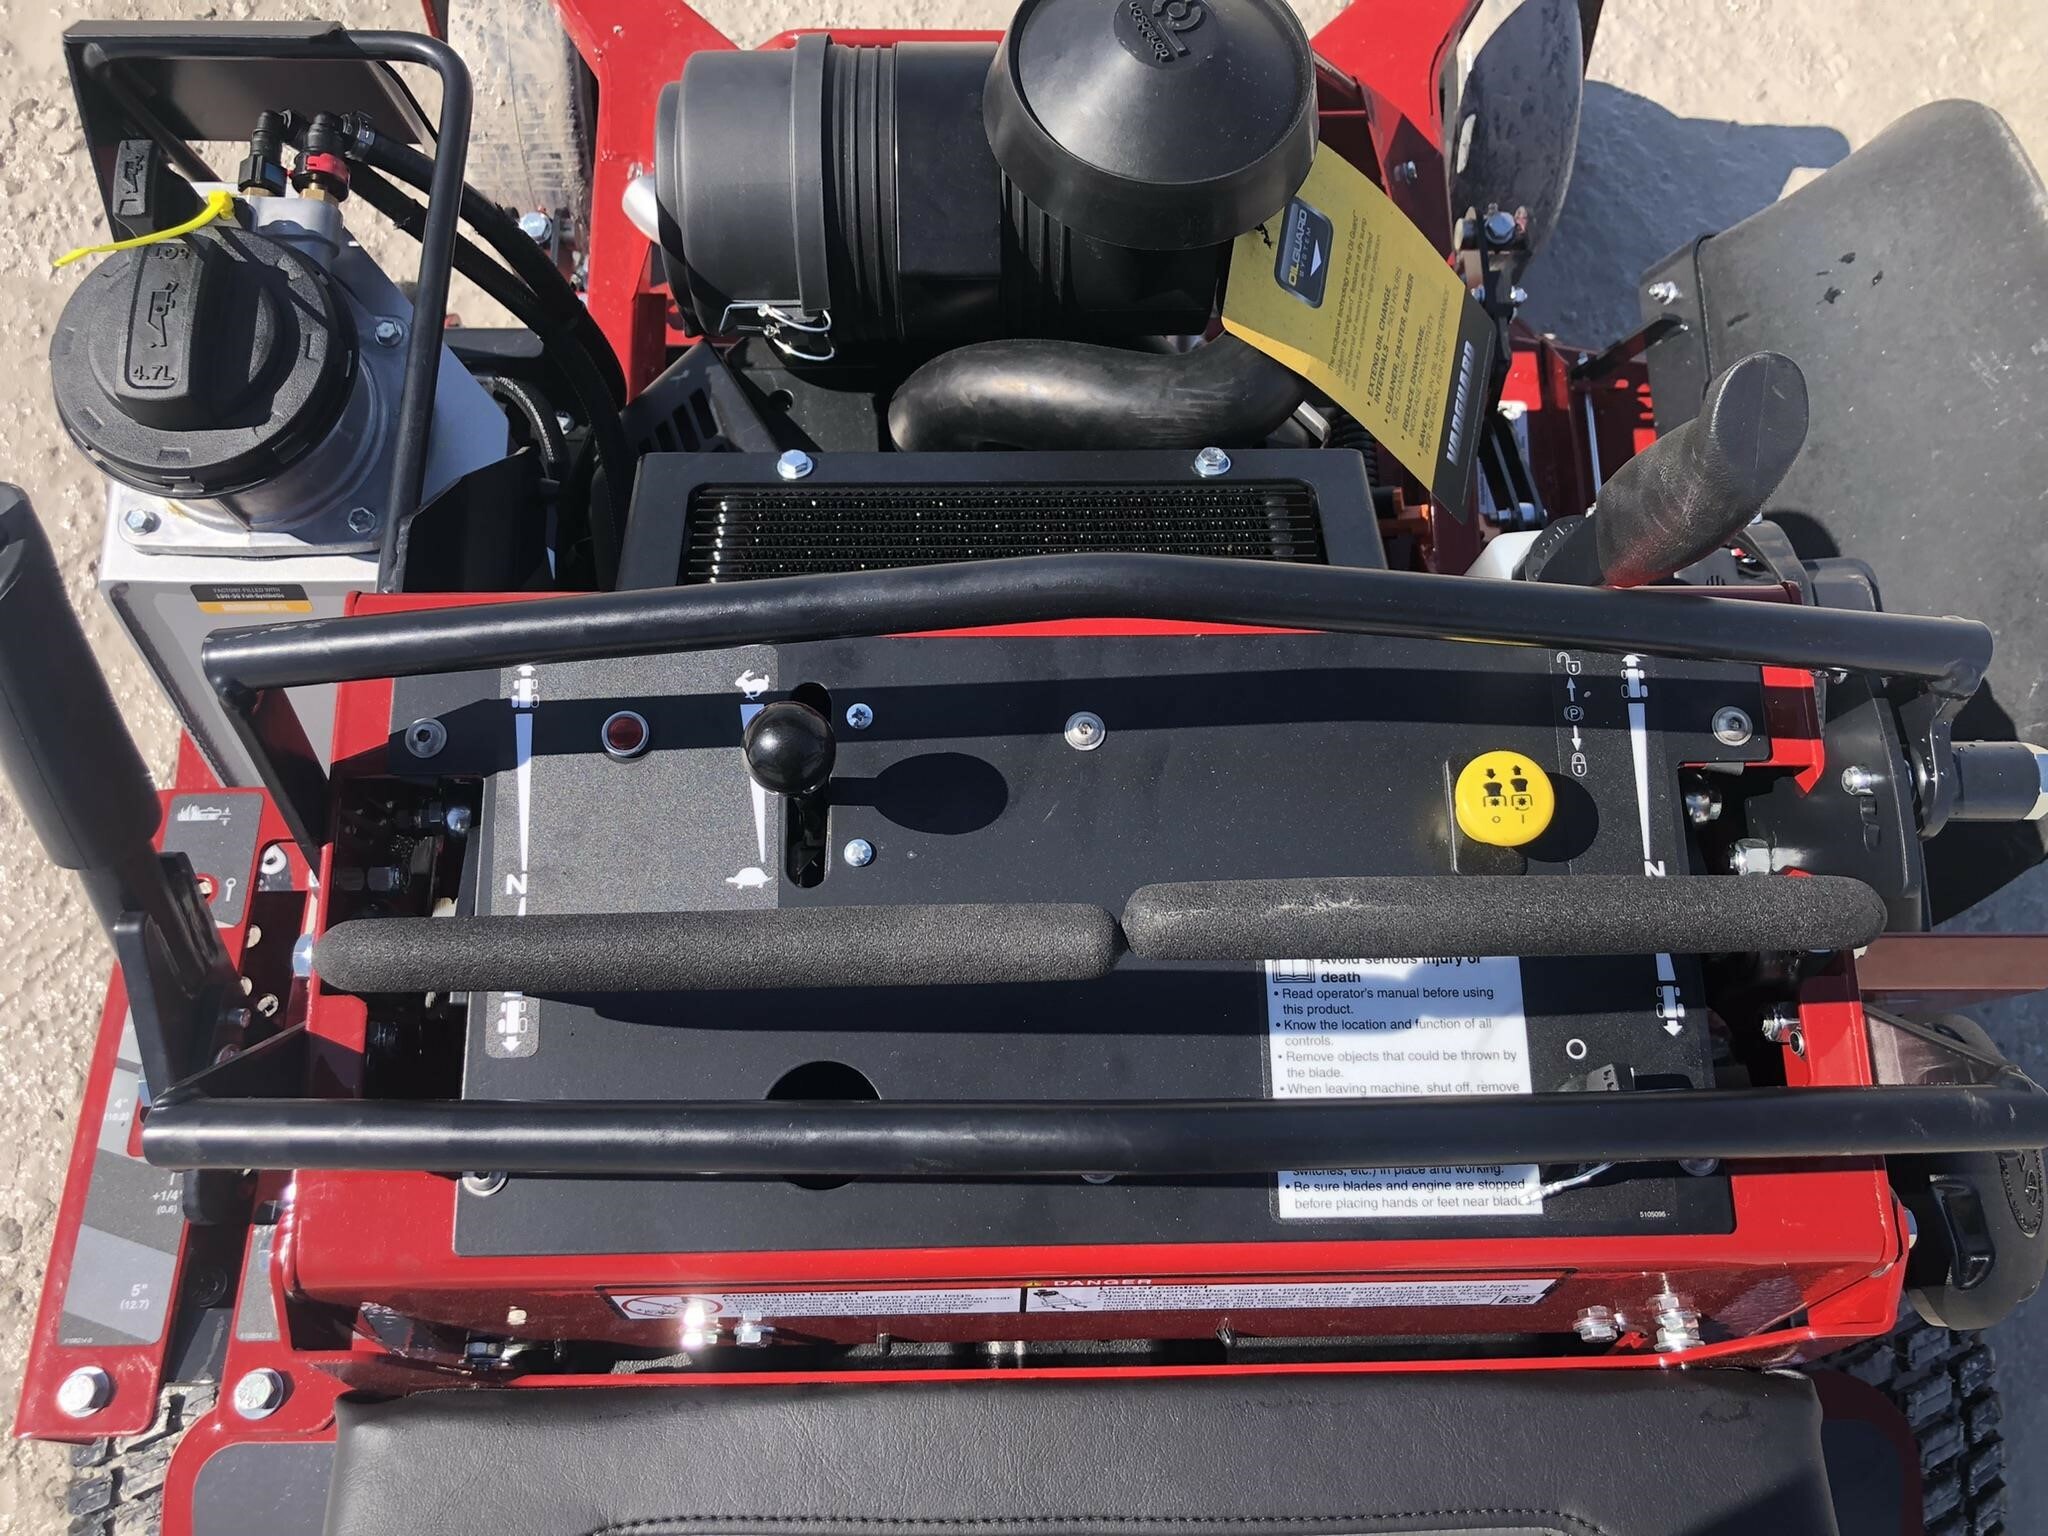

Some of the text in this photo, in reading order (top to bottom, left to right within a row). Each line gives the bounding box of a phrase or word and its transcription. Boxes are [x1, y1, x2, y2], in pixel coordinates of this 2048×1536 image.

[1298, 225, 1311, 278] SYSTEM
[132, 364, 174, 381] 4.7L
[1445, 338, 1477, 467] VANGUARD
[1644, 860, 1666, 877] N
[506, 874, 528, 894] N
[1321, 972, 1360, 983] death
[1282, 987, 1493, 1001] Read operator's manual before using
[1283, 1004, 1353, 1016] this product.
[1284, 1019, 1492, 1030] Know the location and function of all
[1285, 1036, 1333, 1046] controls.
[1286, 1050, 1516, 1063] Remove objects that could be thrown by
[1287, 1067, 1343, 1078] the blade.
[1288, 1082, 1519, 1096] When leaving machine, shut off, remove
[1294, 1179, 1525, 1192] Be sure blades and engine are stopped
[1295, 1198, 1332, 1209] before
[1336, 1198, 1378, 1210] placing
[1382, 1197, 1418, 1208] hands
[1422, 1199, 1432, 1208] or
[1437, 1196, 1459, 1207] feet
[1463, 1198, 1489, 1207] near
[1054, 1278, 1151, 1286] DANGER
[131, 1284, 148, 1297] 5"
[120, 1299, 150, 1310] (12.7)
